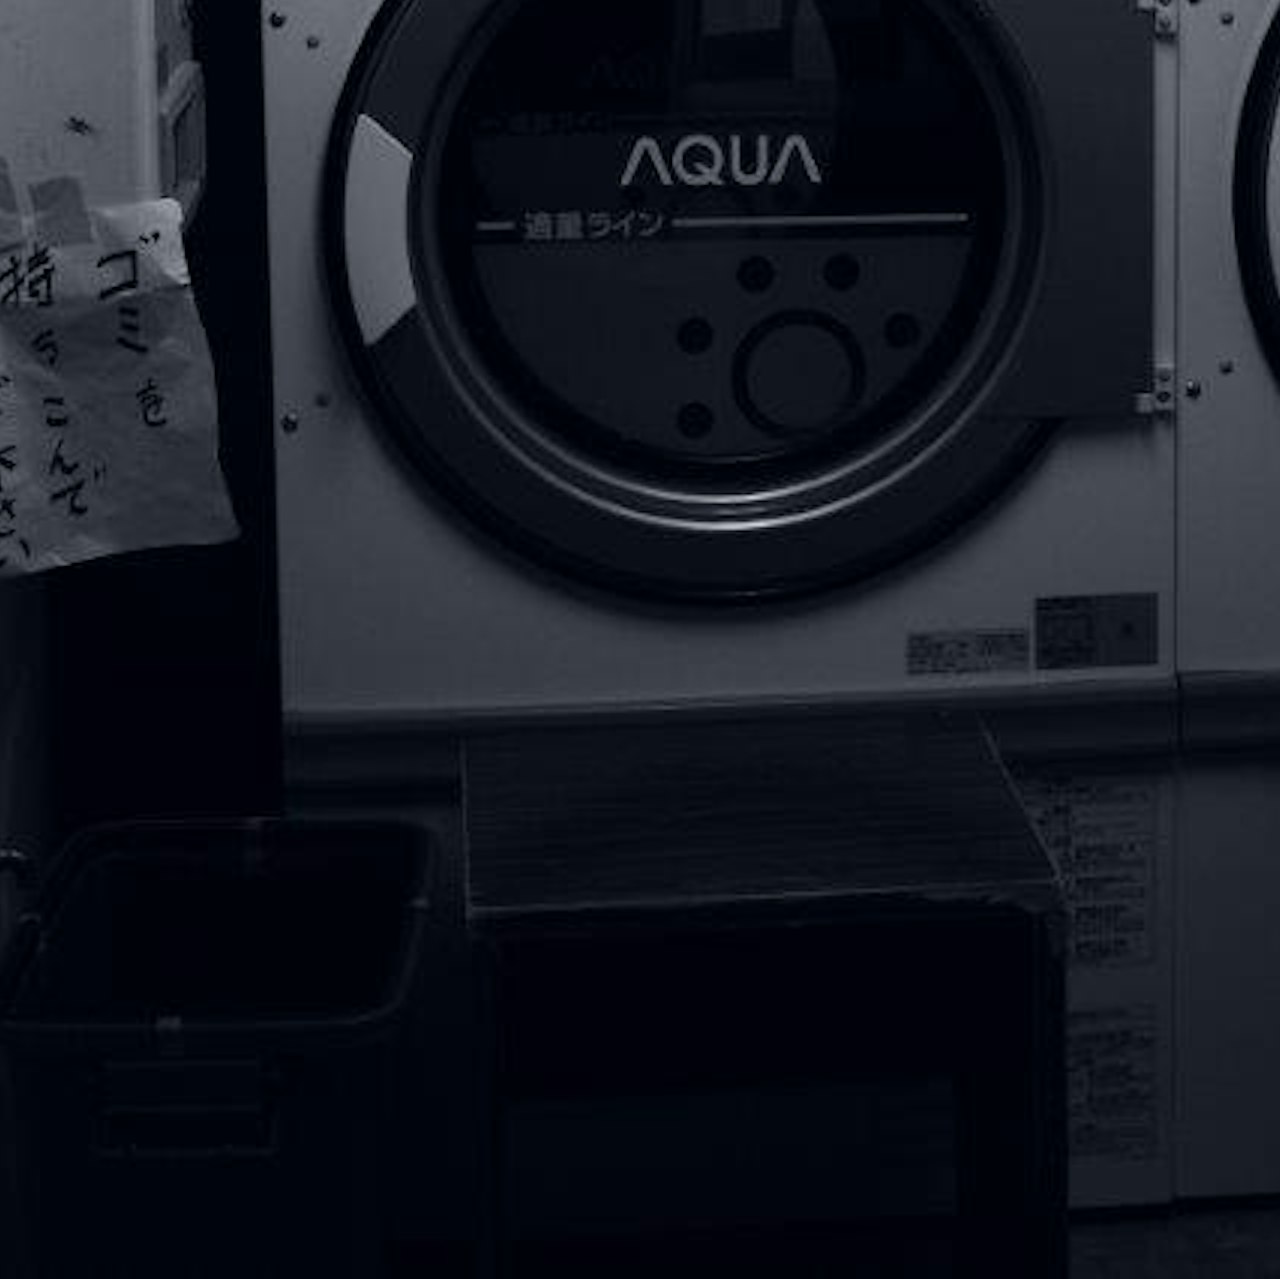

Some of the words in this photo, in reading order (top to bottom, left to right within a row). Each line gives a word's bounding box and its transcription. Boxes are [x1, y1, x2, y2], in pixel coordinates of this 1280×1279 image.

[620, 133, 823, 187] AQUA
[522, 208, 666, 241] 適量ライン
